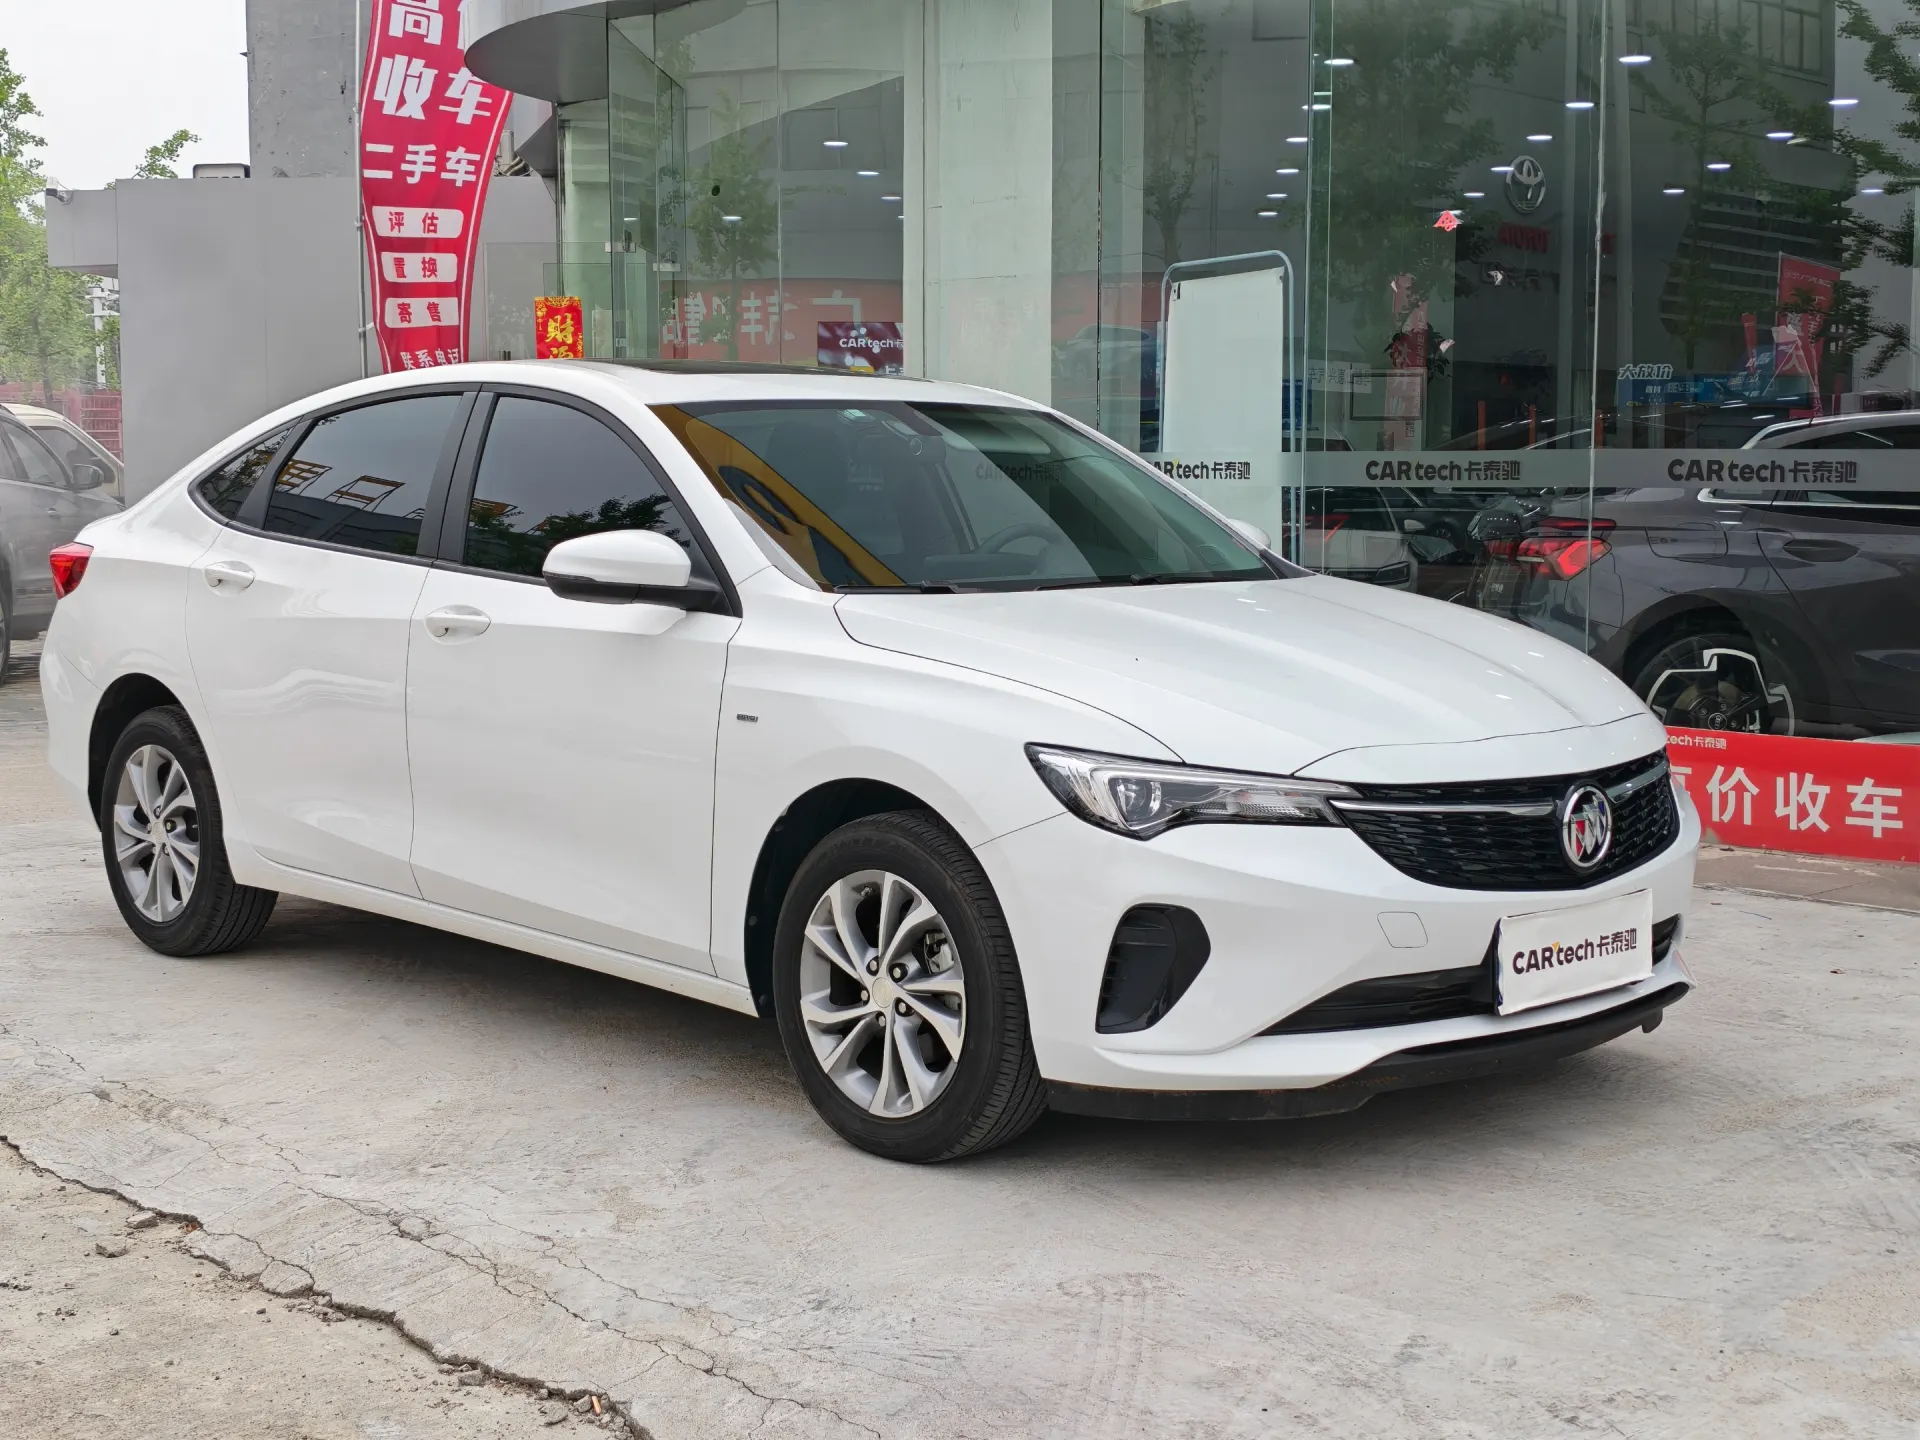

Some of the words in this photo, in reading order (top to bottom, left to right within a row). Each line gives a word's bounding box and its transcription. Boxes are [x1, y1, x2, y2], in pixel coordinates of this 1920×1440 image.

[388, 0, 465, 50] 高
[373, 54, 493, 125] 收车
[363, 142, 481, 187] 二手车
[388, 211, 439, 235] 评估
[393, 256, 438, 279] 置换
[397, 301, 442, 324] 寄售
[400, 348, 459, 370] 联系电话
[1670, 763, 1904, 838] 价收车
